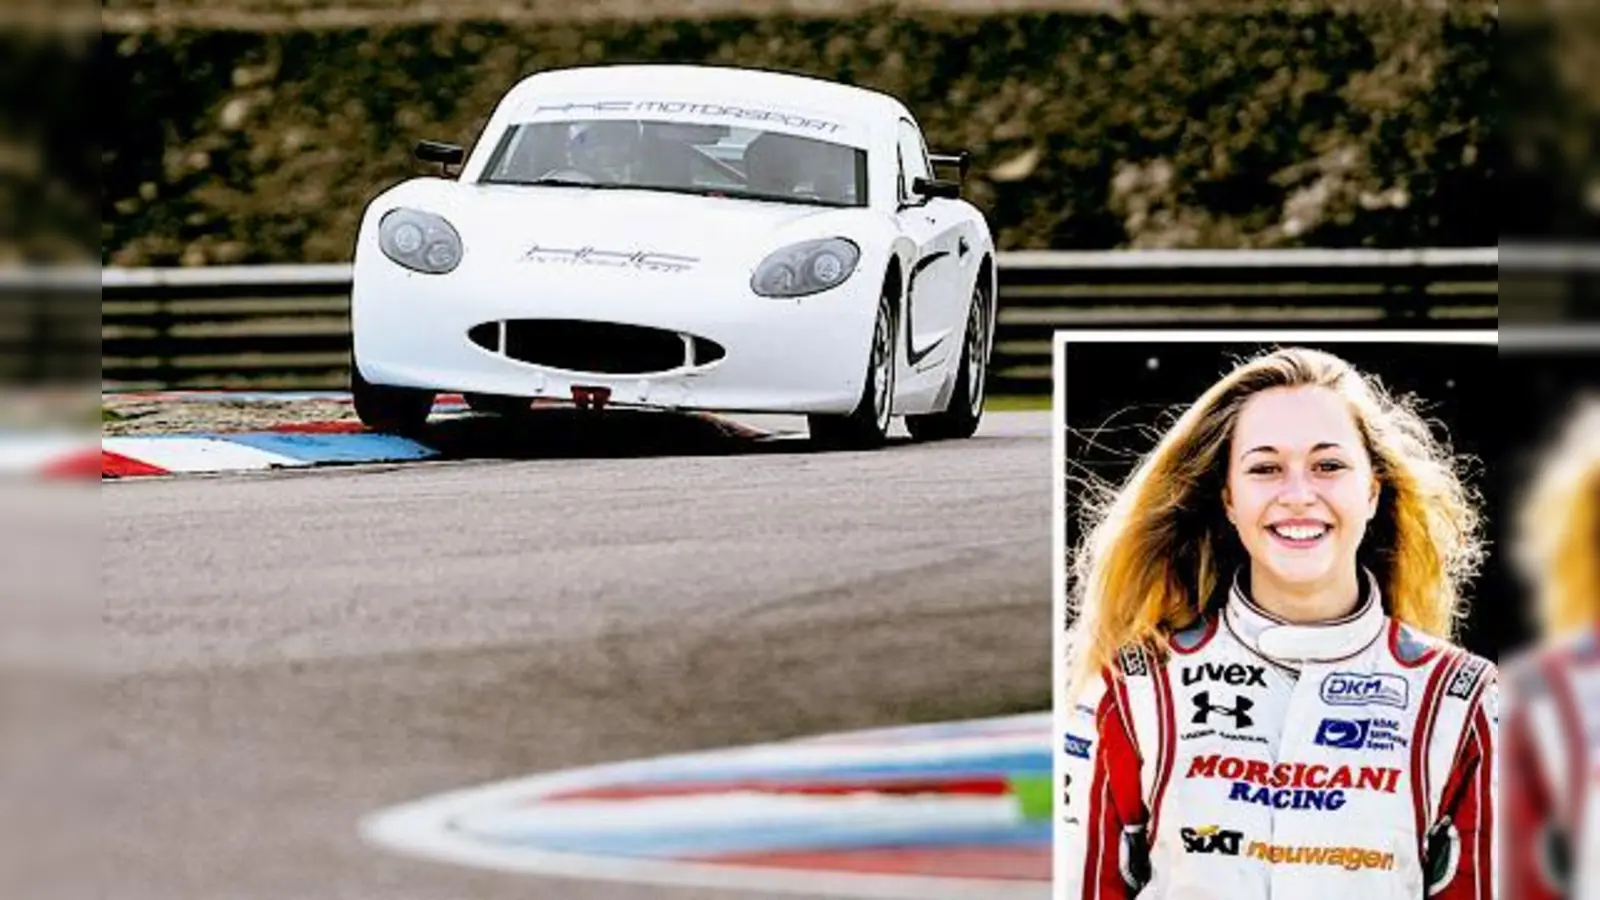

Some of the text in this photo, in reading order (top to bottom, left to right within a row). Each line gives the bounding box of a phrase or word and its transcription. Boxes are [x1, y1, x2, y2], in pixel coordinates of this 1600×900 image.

[635, 100, 843, 134] MOTORSPORT
[1181, 662, 1267, 688] uvex
[1328, 679, 1382, 696] DKM
[1186, 754, 1402, 793] MORSICANI
[1228, 782, 1346, 811] RACING
[1246, 839, 1395, 871] neuwagen
